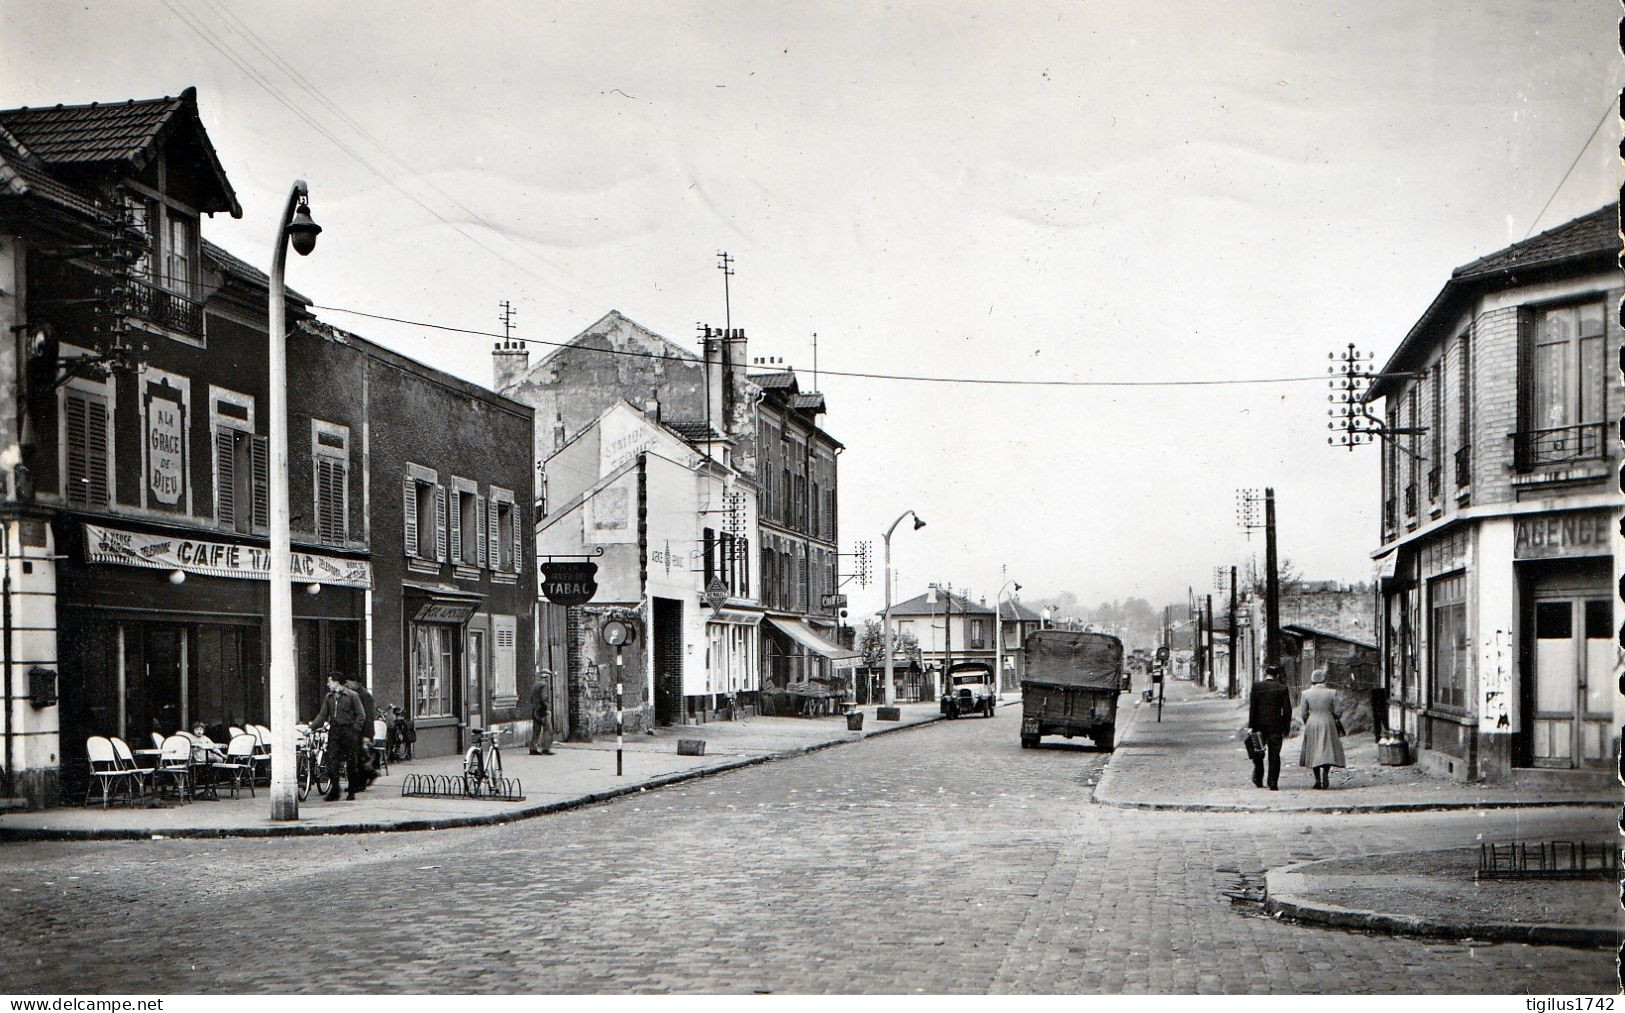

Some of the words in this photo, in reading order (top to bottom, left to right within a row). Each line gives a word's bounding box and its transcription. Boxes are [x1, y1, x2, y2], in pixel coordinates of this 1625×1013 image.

[160, 458, 171, 469] DE
[152, 468, 178, 494] DIEU
[1514, 516, 1610, 549] AGENCE
[177, 541, 240, 568] CAFÉ
[547, 582, 590, 595] TABAC
